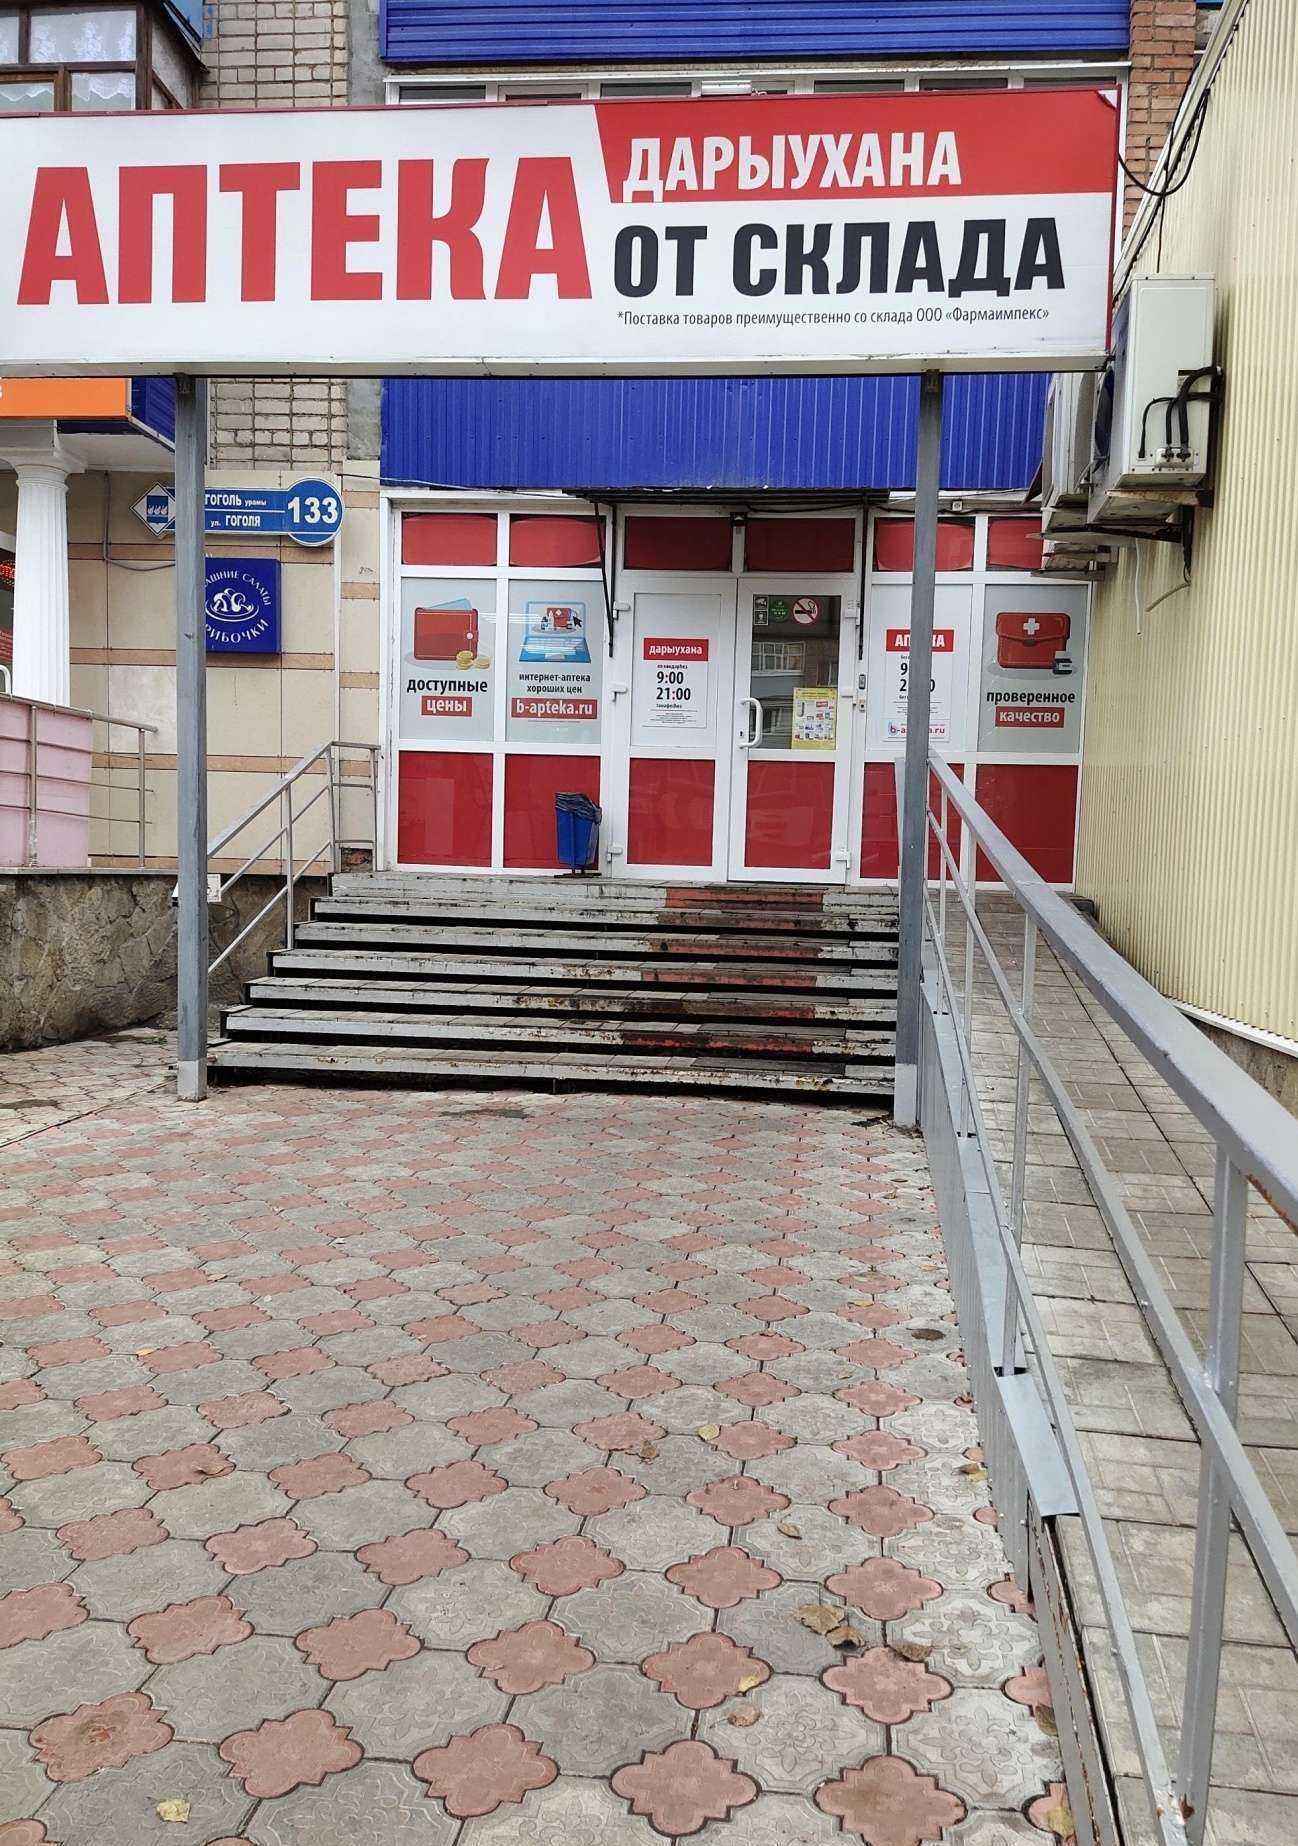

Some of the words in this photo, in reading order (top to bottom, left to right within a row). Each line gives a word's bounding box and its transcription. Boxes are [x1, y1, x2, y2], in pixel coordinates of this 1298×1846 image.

[622, 131, 962, 203] ДАРЫУХАНА
[17, 156, 593, 305] АПТЕКА
[613, 224, 708, 298] ОТ
[732, 217, 1066, 298] СКЛАДА
[683, 312, 733, 327] товаров
[736, 311, 851, 328] преимущественно
[854, 312, 867, 323] со
[870, 310, 913, 325] склада
[916, 307, 943, 322] ООО
[945, 306, 1050, 325] «Фармаимпекс»
[204, 494, 242, 506] ГОГОЛЬ
[287, 496, 338, 524] 133
[210, 520, 221, 528] ул.
[225, 514, 261, 527] ГОГОЛЯ
[204, 619, 269, 643] РИБОЧКИ
[648, 643, 703, 657] дарыухана
[519, 672, 591, 685] интернет-аптека
[656, 671, 684, 685] 9:00
[406, 678, 488, 695] доступные
[526, 684, 565, 695] хороших
[566, 686, 583, 695] цен
[656, 687, 691, 701] 21:00
[986, 690, 1076, 705] проверенное
[426, 699, 467, 714] цены
[516, 698, 593, 717] b-apteka.ru
[999, 709, 1060, 723] качество
